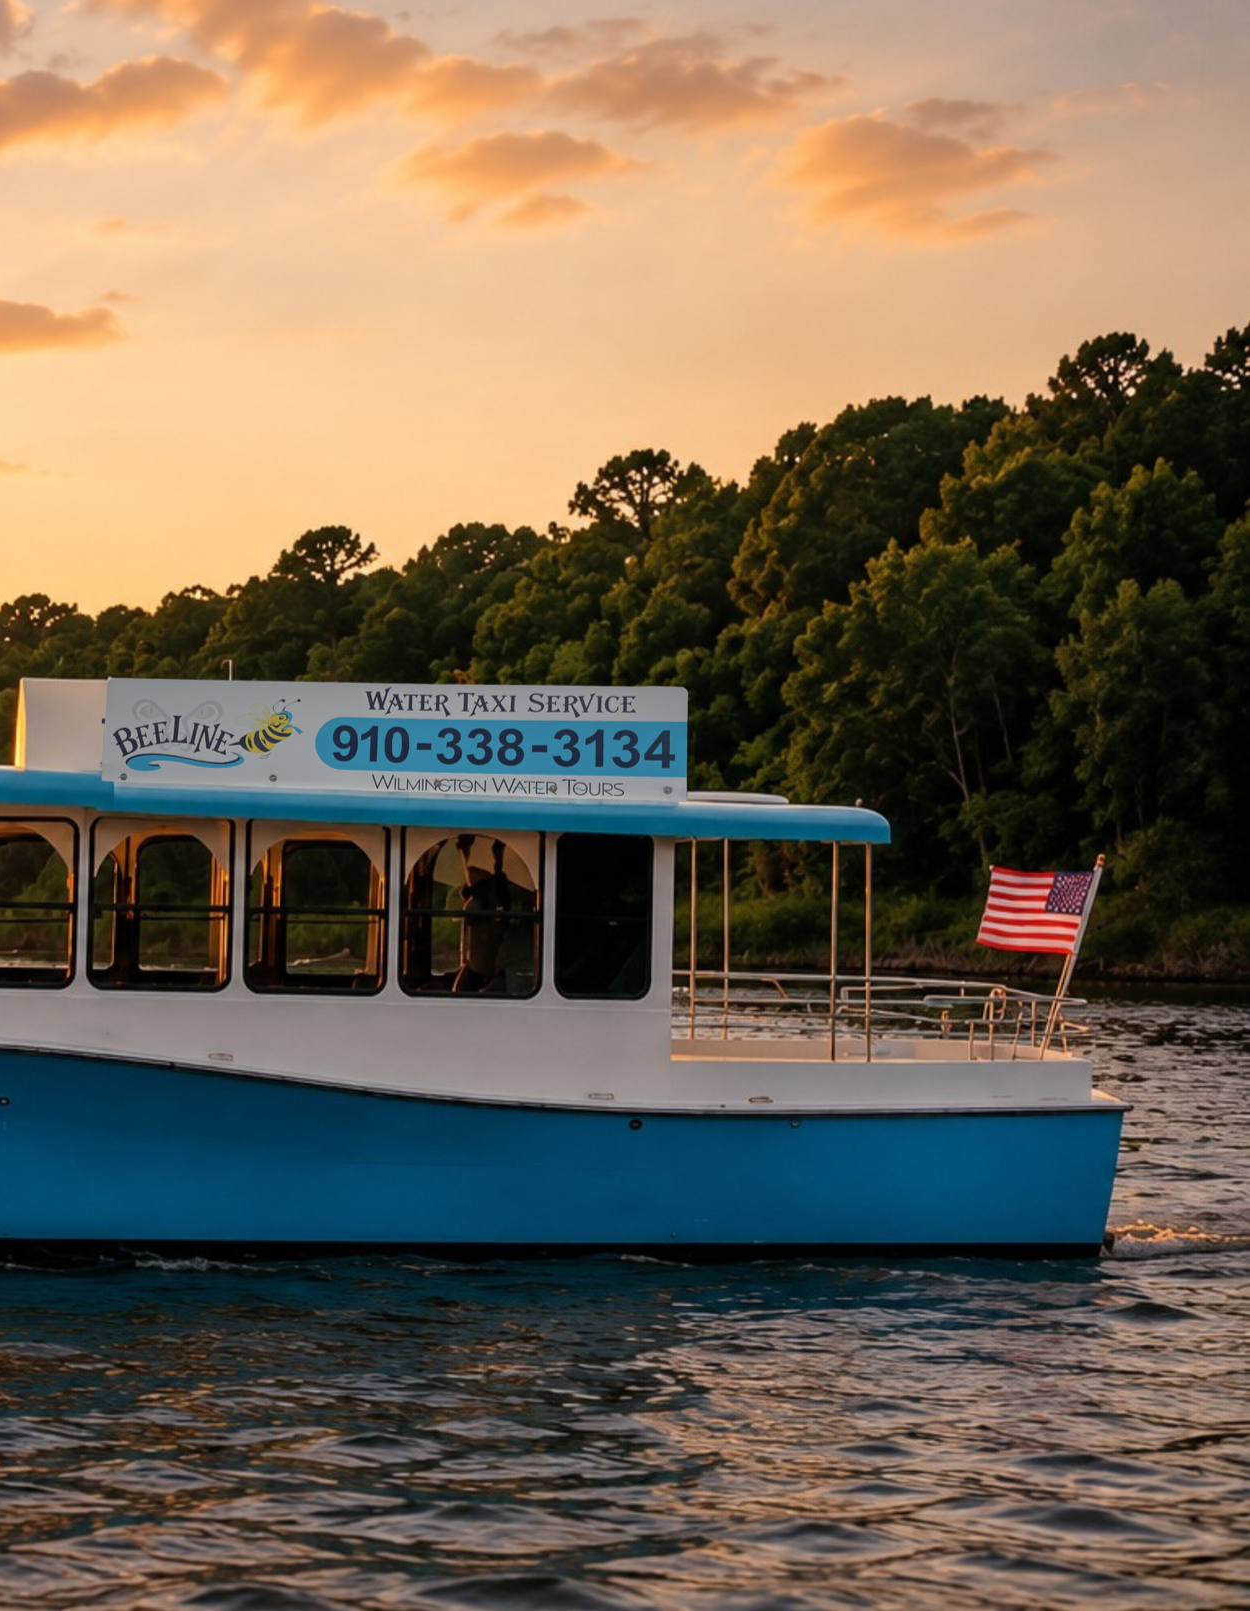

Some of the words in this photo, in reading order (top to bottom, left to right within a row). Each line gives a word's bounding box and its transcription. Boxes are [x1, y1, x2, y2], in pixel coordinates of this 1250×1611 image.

[365, 686, 451, 717] WATER
[457, 692, 516, 717] TAXI
[527, 692, 637, 718] SERVICE
[112, 715, 235, 758] BEELINE
[332, 724, 676, 769] 910-338-3134
[371, 774, 487, 793] WILMINGTON
[492, 777, 558, 796] WATER
[562, 778, 625, 797] TOURS
